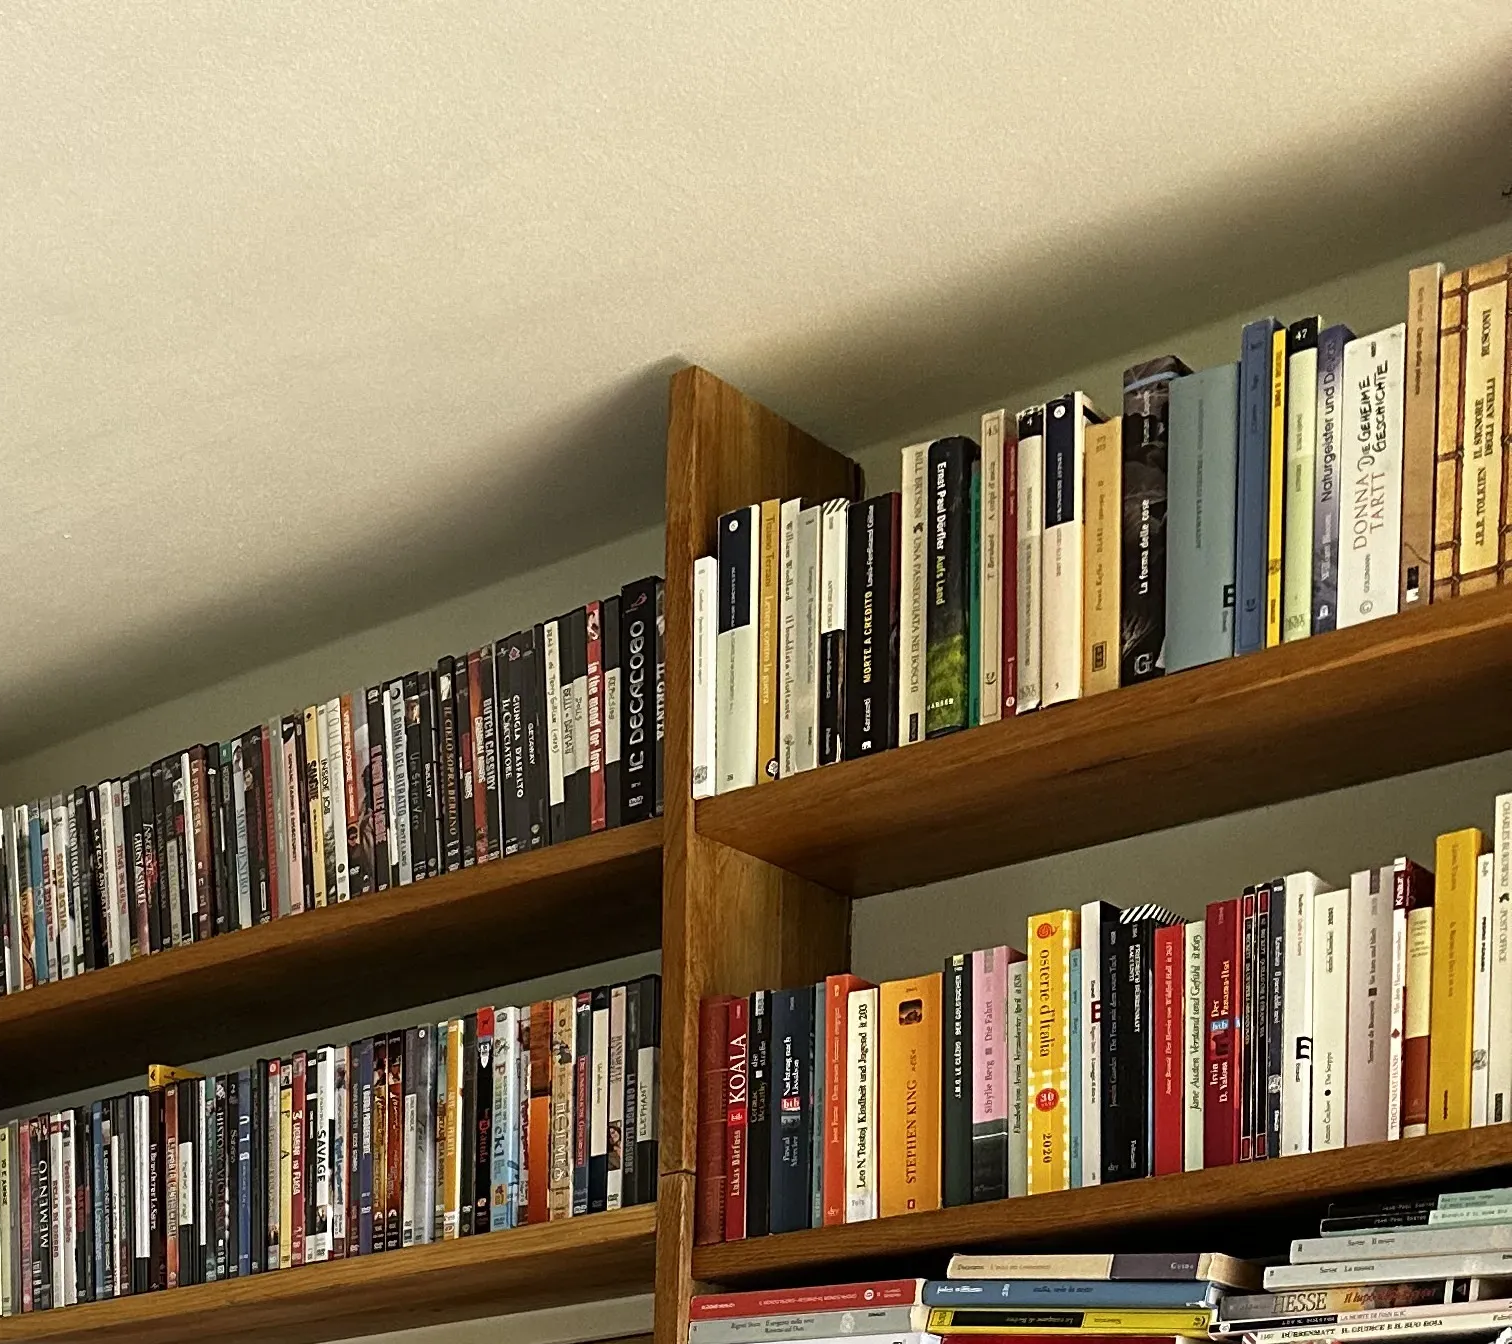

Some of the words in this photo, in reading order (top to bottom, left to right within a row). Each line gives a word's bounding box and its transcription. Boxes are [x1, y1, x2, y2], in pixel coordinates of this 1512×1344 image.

[1295, 328, 1308, 341] 47
[1481, 309, 1491, 357] RUSCONI
[1324, 395, 1334, 423] und
[1358, 375, 1371, 442] GEHEIME
[1373, 360, 1388, 453] GESCHICHTE
[1487, 377, 1496, 421] ANELLI
[1474, 398, 1484, 447] SIGNORE
[1473, 450, 1482, 460] IL
[1486, 424, 1495, 457] DEGLI
[937, 462, 947, 489] Ernst
[1321, 427, 1333, 502] Naturgeister
[937, 492, 947, 514] Paul
[1370, 472, 1385, 534] TARTT
[1476, 467, 1486, 515] TOLKIEN
[1141, 500, 1149, 519] cose
[1353, 473, 1369, 550] DONNA
[1140, 521, 1149, 546] delle
[1139, 548, 1149, 579] forma
[936, 582, 945, 605] Land
[1139, 583, 1148, 594] La
[864, 591, 873, 632] CREDITO
[864, 635, 872, 645] A
[863, 648, 872, 684] MORTE
[588, 674, 599, 694] the
[588, 698, 600, 726] mood
[328, 706, 341, 761] YOUTH
[445, 718, 453, 749] CIELO
[528, 723, 536, 765] GETAWAY
[589, 728, 600, 747] for
[446, 751, 455, 785] SOPRA
[515, 746, 524, 798] D'ASFALTO
[590, 748, 601, 774] love
[237, 808, 245, 841] MARE
[449, 788, 458, 836] BERLINO
[239, 846, 248, 895] DENTRO
[1395, 876, 1404, 907] Knaur
[1039, 949, 1049, 1007] osterie
[985, 1000, 993, 1026] Fahrt
[859, 1033, 868, 1066] Jugend
[1040, 1009, 1055, 1057] d'Italia
[729, 1033, 747, 1105] KOALA
[858, 1067, 867, 1087] und
[985, 1060, 994, 1078] Berg
[782, 1096, 800, 1110] btb
[858, 1088, 867, 1124] Kindheit
[906, 1080, 917, 1121] KING
[984, 1079, 993, 1114] Sibylle
[317, 1129, 326, 1182] SAVAGE
[905, 1123, 917, 1184] STEPHEN
[1042, 1133, 1053, 1164] 2020
[730, 1166, 741, 1196] Lukas
[856, 1170, 866, 1188] Leo
[39, 1160, 48, 1248] MEMENTO
[1271, 1291, 1327, 1314] HESSE
